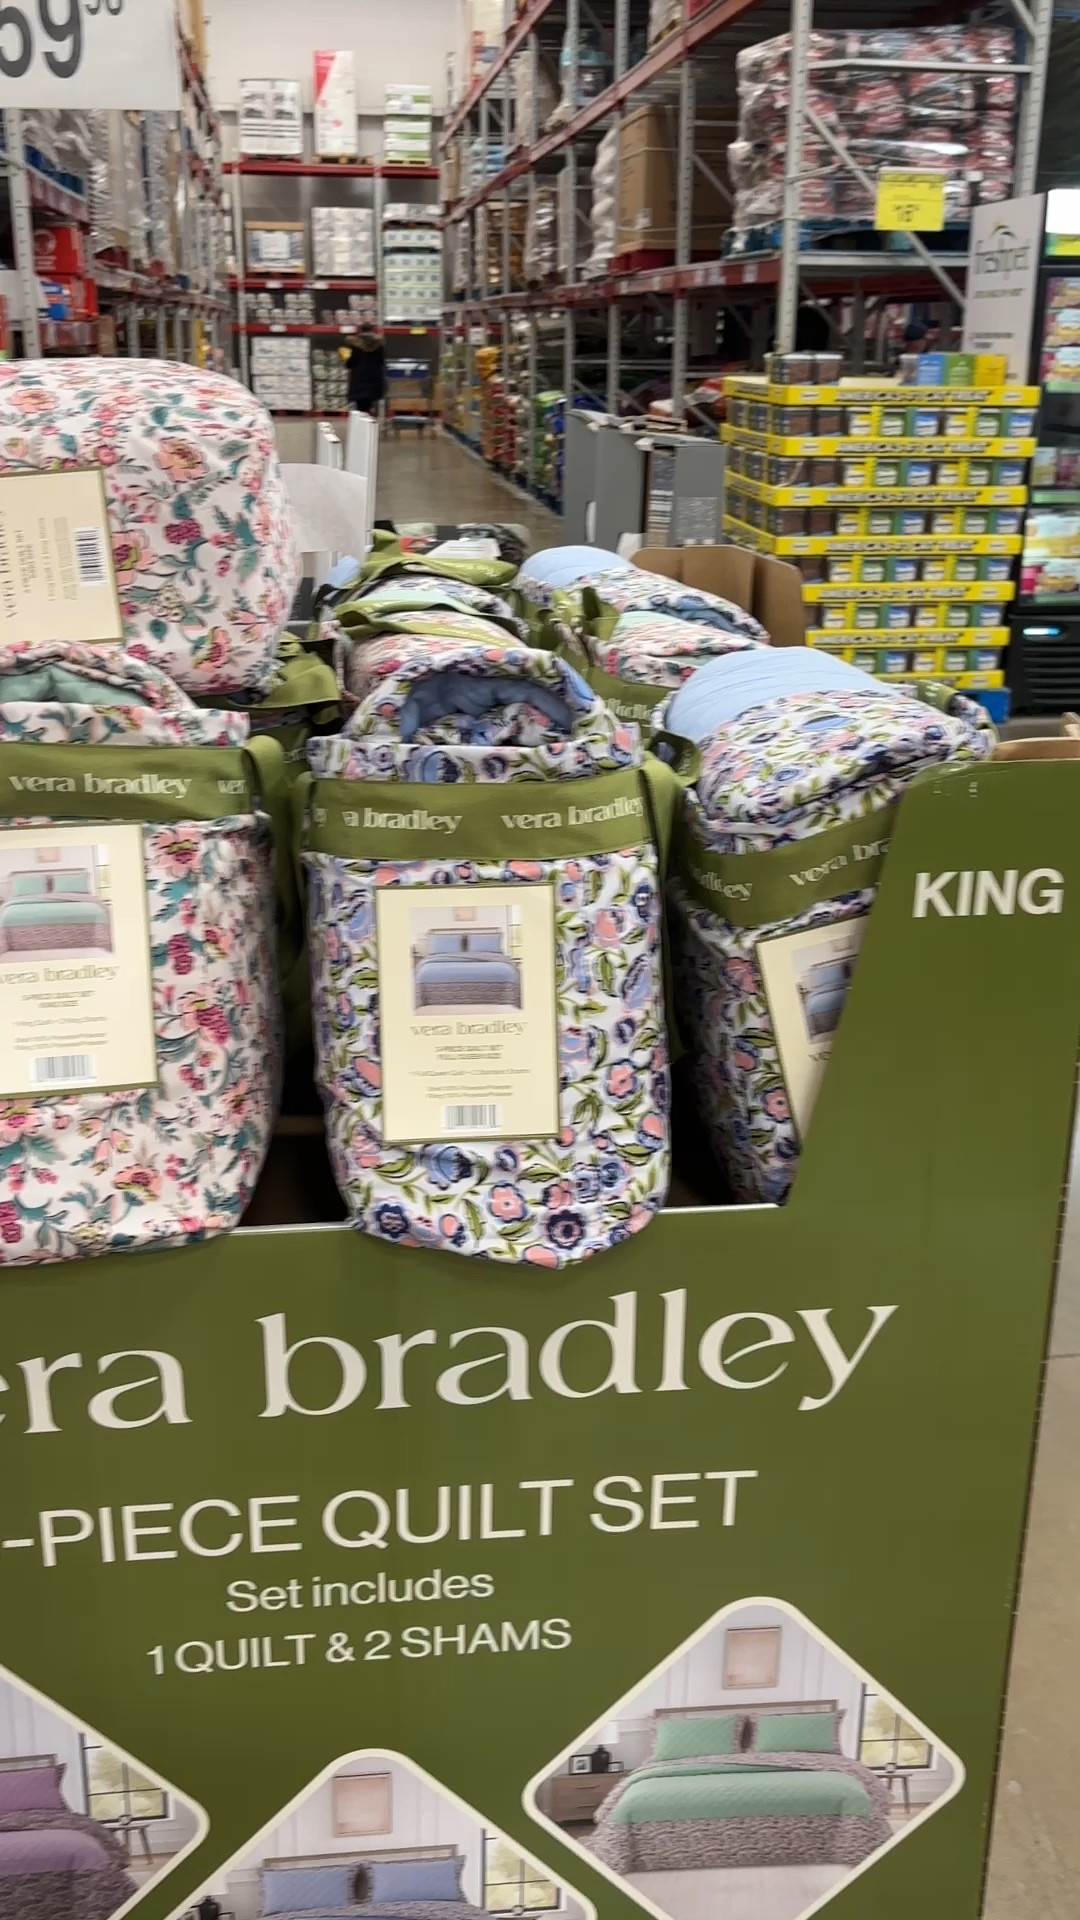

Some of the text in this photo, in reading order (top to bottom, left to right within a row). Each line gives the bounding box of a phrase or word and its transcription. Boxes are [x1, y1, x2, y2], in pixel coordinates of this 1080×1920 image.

[8, 775, 76, 792] vera
[84, 773, 192, 798] bradley
[363, 807, 463, 835] bradley
[500, 811, 563, 830] vera
[789, 854, 848, 886] vera
[912, 868, 1065, 918] KING
[43, 965, 120, 981] bradley
[456, 1020, 528, 1036] bradley
[0, 1288, 899, 1434] ra bradley
[321, 1478, 575, 1550] QUILT
[590, 1469, 759, 1533] SET
[225, 1568, 496, 1613] Set includes
[146, 1617, 573, 1675] 1 QUILT & 2 SHAMS
